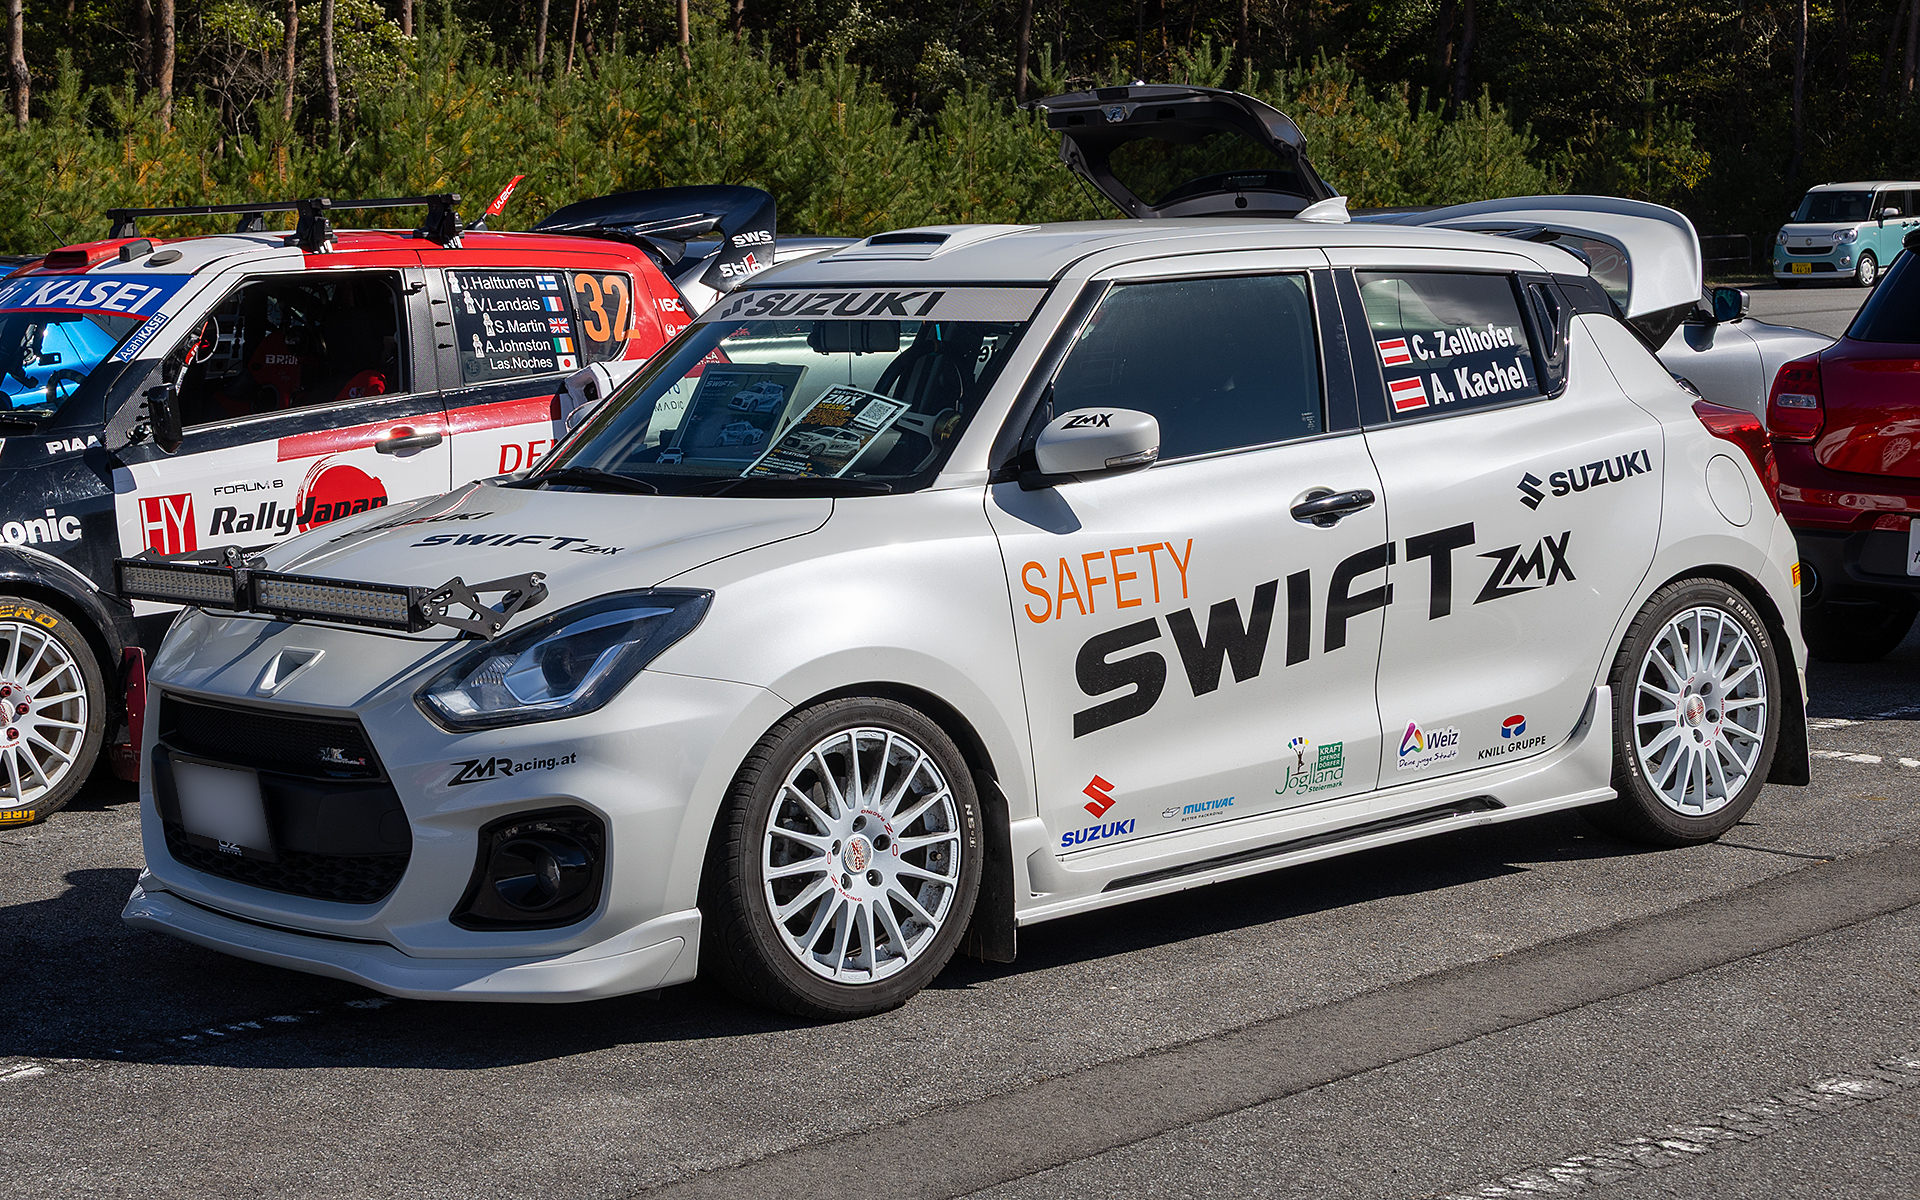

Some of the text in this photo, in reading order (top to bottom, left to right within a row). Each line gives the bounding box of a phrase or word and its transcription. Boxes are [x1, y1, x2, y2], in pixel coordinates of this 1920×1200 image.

[732, 230, 773, 246] SWS
[461, 276, 535, 290] J.Halttunen
[21, 280, 163, 314] KASEI
[474, 297, 540, 312] V.Landais
[744, 292, 947, 317] SUZUKI
[574, 273, 641, 342] 32
[495, 319, 547, 334] S.Martin
[486, 340, 551, 353] A.Johnston
[1411, 322, 1515, 361] C. Zellhofer
[490, 358, 553, 370] Las.Noches
[1430, 357, 1529, 405] A. Kachel
[822, 393, 864, 407] ZMX
[1060, 413, 1114, 431] ZMX
[45, 434, 103, 455] PIAA
[1547, 448, 1653, 498] SUZUKI
[213, 479, 284, 496] FORUM 8
[0, 508, 83, 545] onic
[140, 495, 191, 556] HY
[409, 533, 588, 551] SWIFT
[1022, 538, 1194, 625] SAFETY
[1072, 522, 1577, 740] SWIFT ZMX
[1427, 729, 1458, 750] Weiz
[1478, 735, 1547, 760] KNILL GRUPPE
[1320, 745, 1341, 755] KRAFT
[1320, 752, 1341, 761] SPENDE
[1399, 750, 1457, 768] Deine junge Stadt
[447, 752, 577, 787] ZMRacing.at
[1319, 760, 1341, 769] DÖRFER
[1275, 756, 1346, 796] Joglland
[1308, 781, 1343, 794] Steiermark
[1182, 796, 1235, 815] MULTIVAC
[861, 809, 886, 822] RACING
[1060, 819, 1136, 848] SUZUKI
